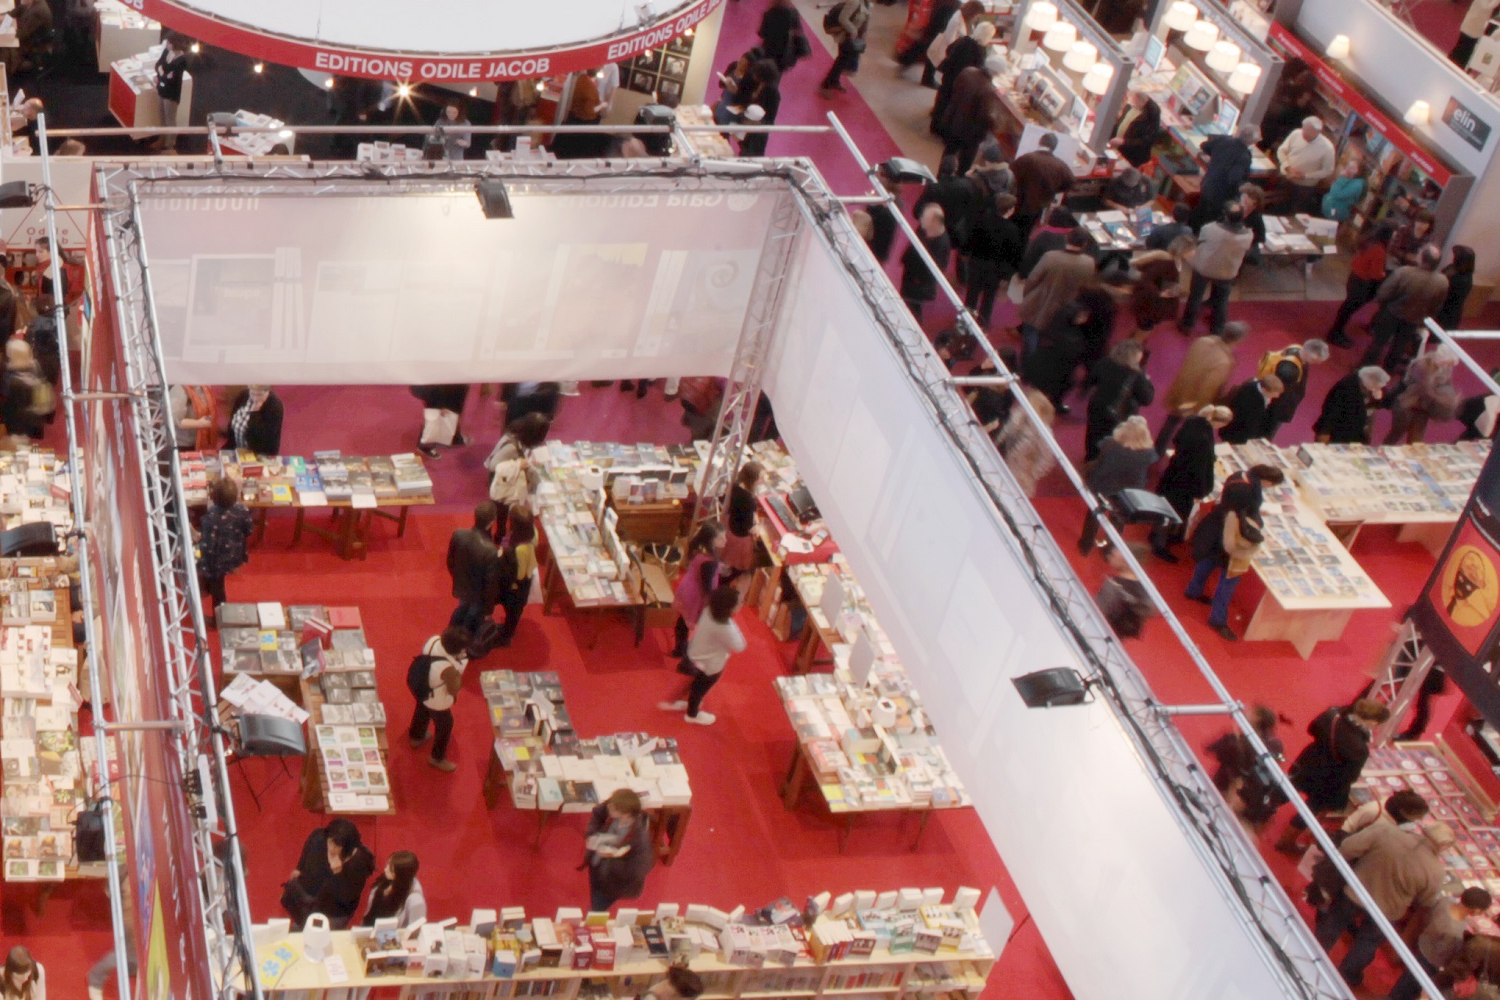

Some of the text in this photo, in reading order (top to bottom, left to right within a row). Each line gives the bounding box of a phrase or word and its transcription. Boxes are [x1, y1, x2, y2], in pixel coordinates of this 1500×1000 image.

[607, 23, 673, 61] EDITIONS
[675, 2, 708, 34] ODILE
[314, 51, 550, 79] EDITIONS ODILE JACOB
[26, 227, 68, 236] Odle
